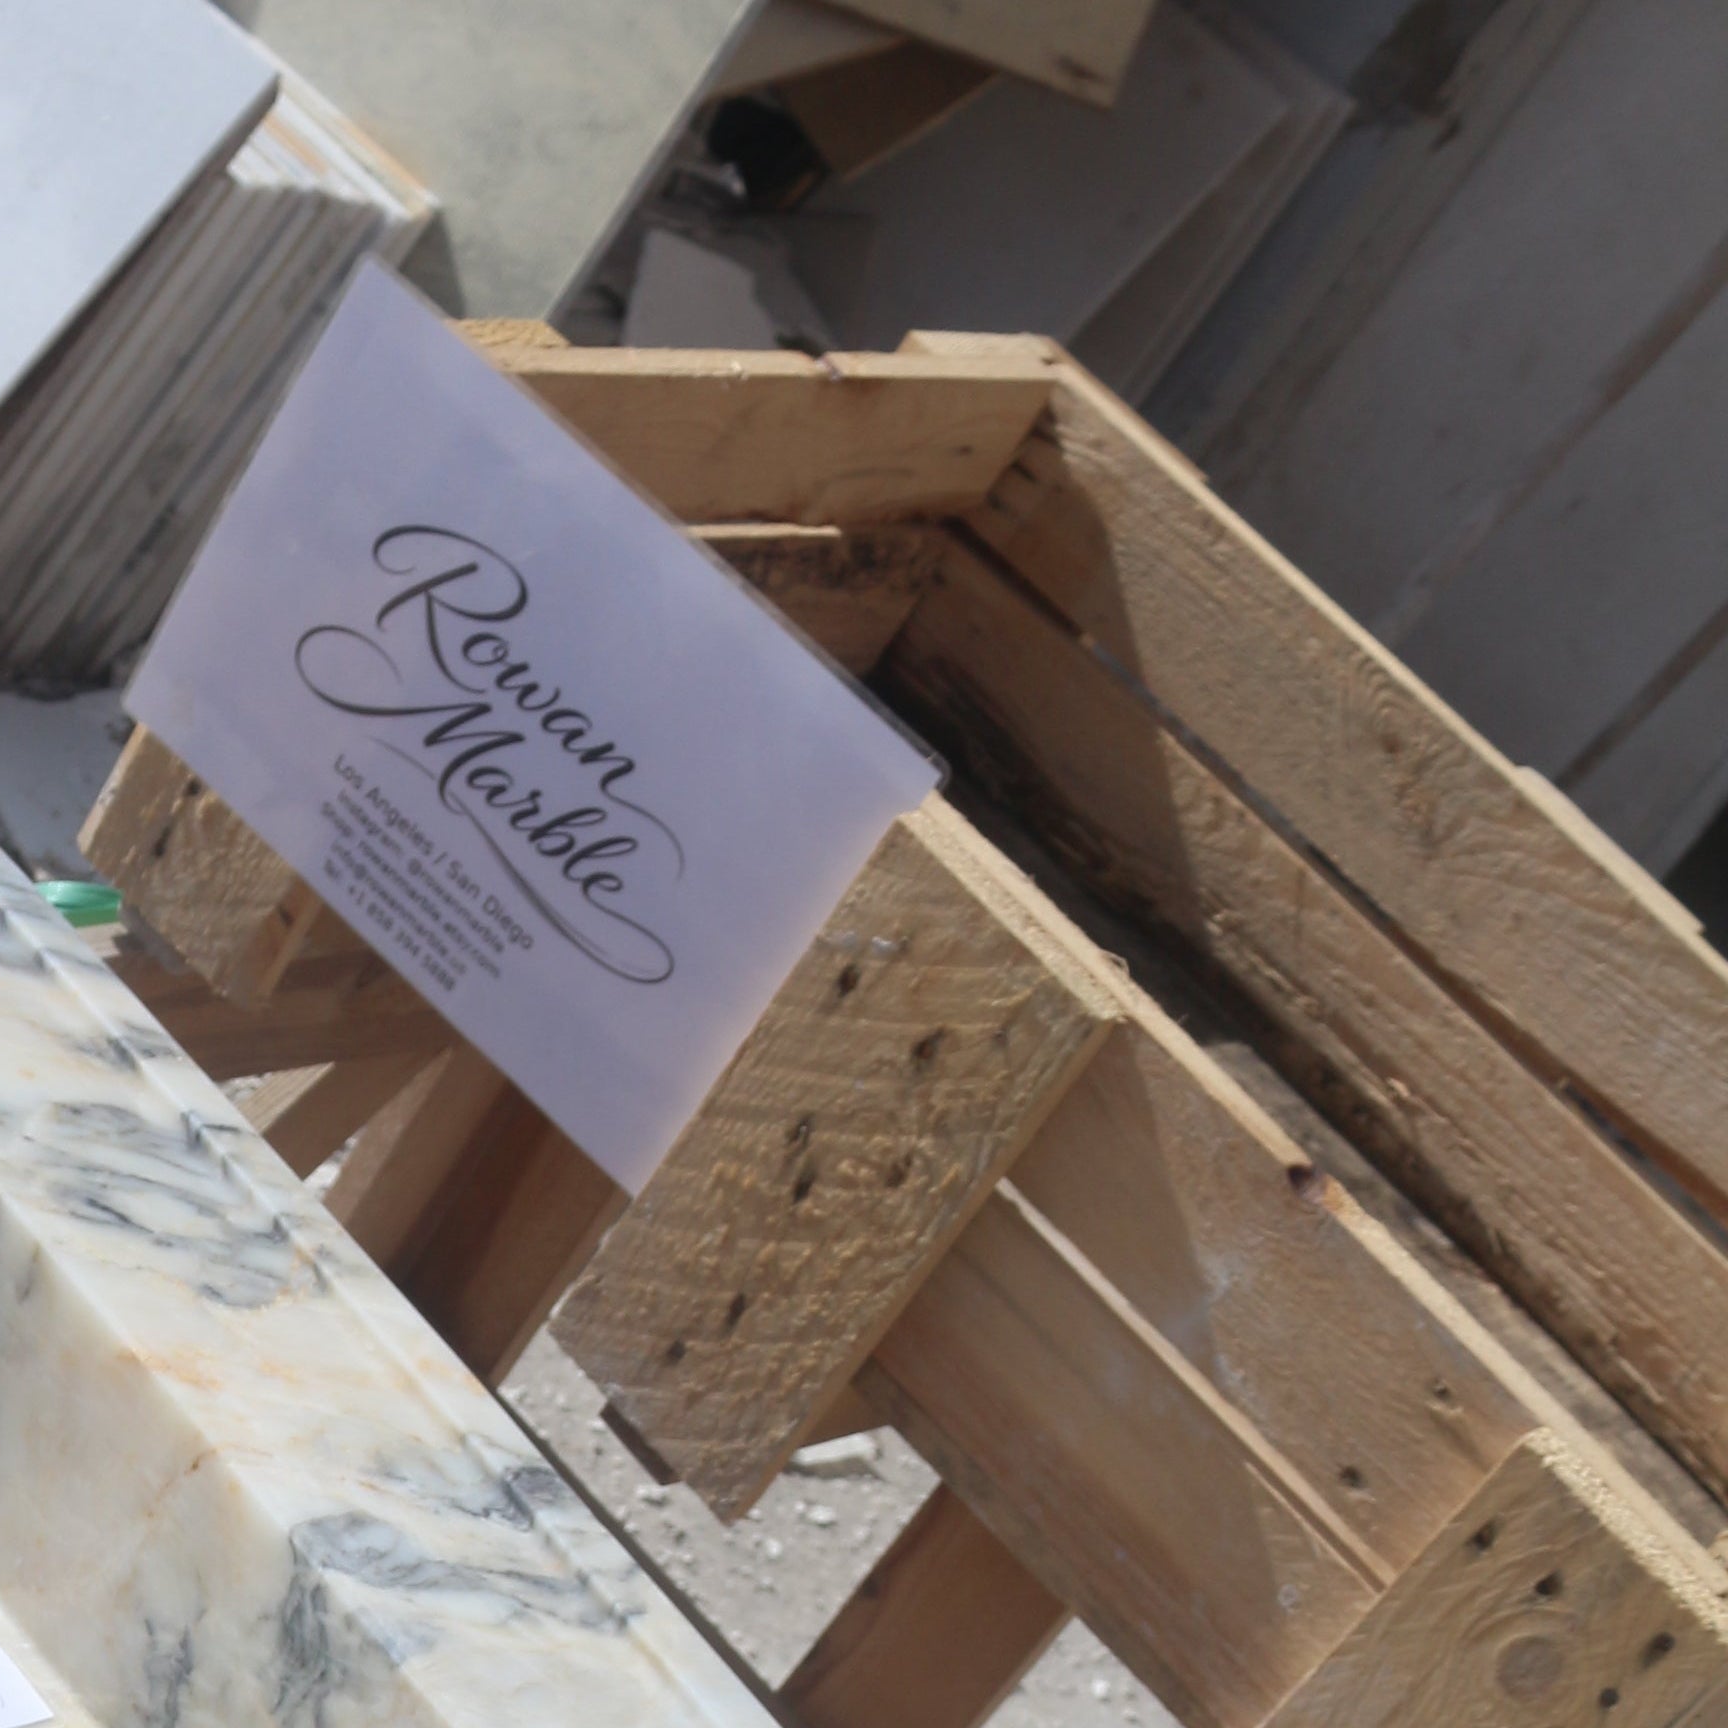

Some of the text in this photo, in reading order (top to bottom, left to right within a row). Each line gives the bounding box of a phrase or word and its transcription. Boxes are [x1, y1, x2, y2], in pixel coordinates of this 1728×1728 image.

[294, 624, 675, 985] Marble
[333, 753, 534, 950] Los Angeles / San Diego
[372, 525, 685, 880] Rowan
